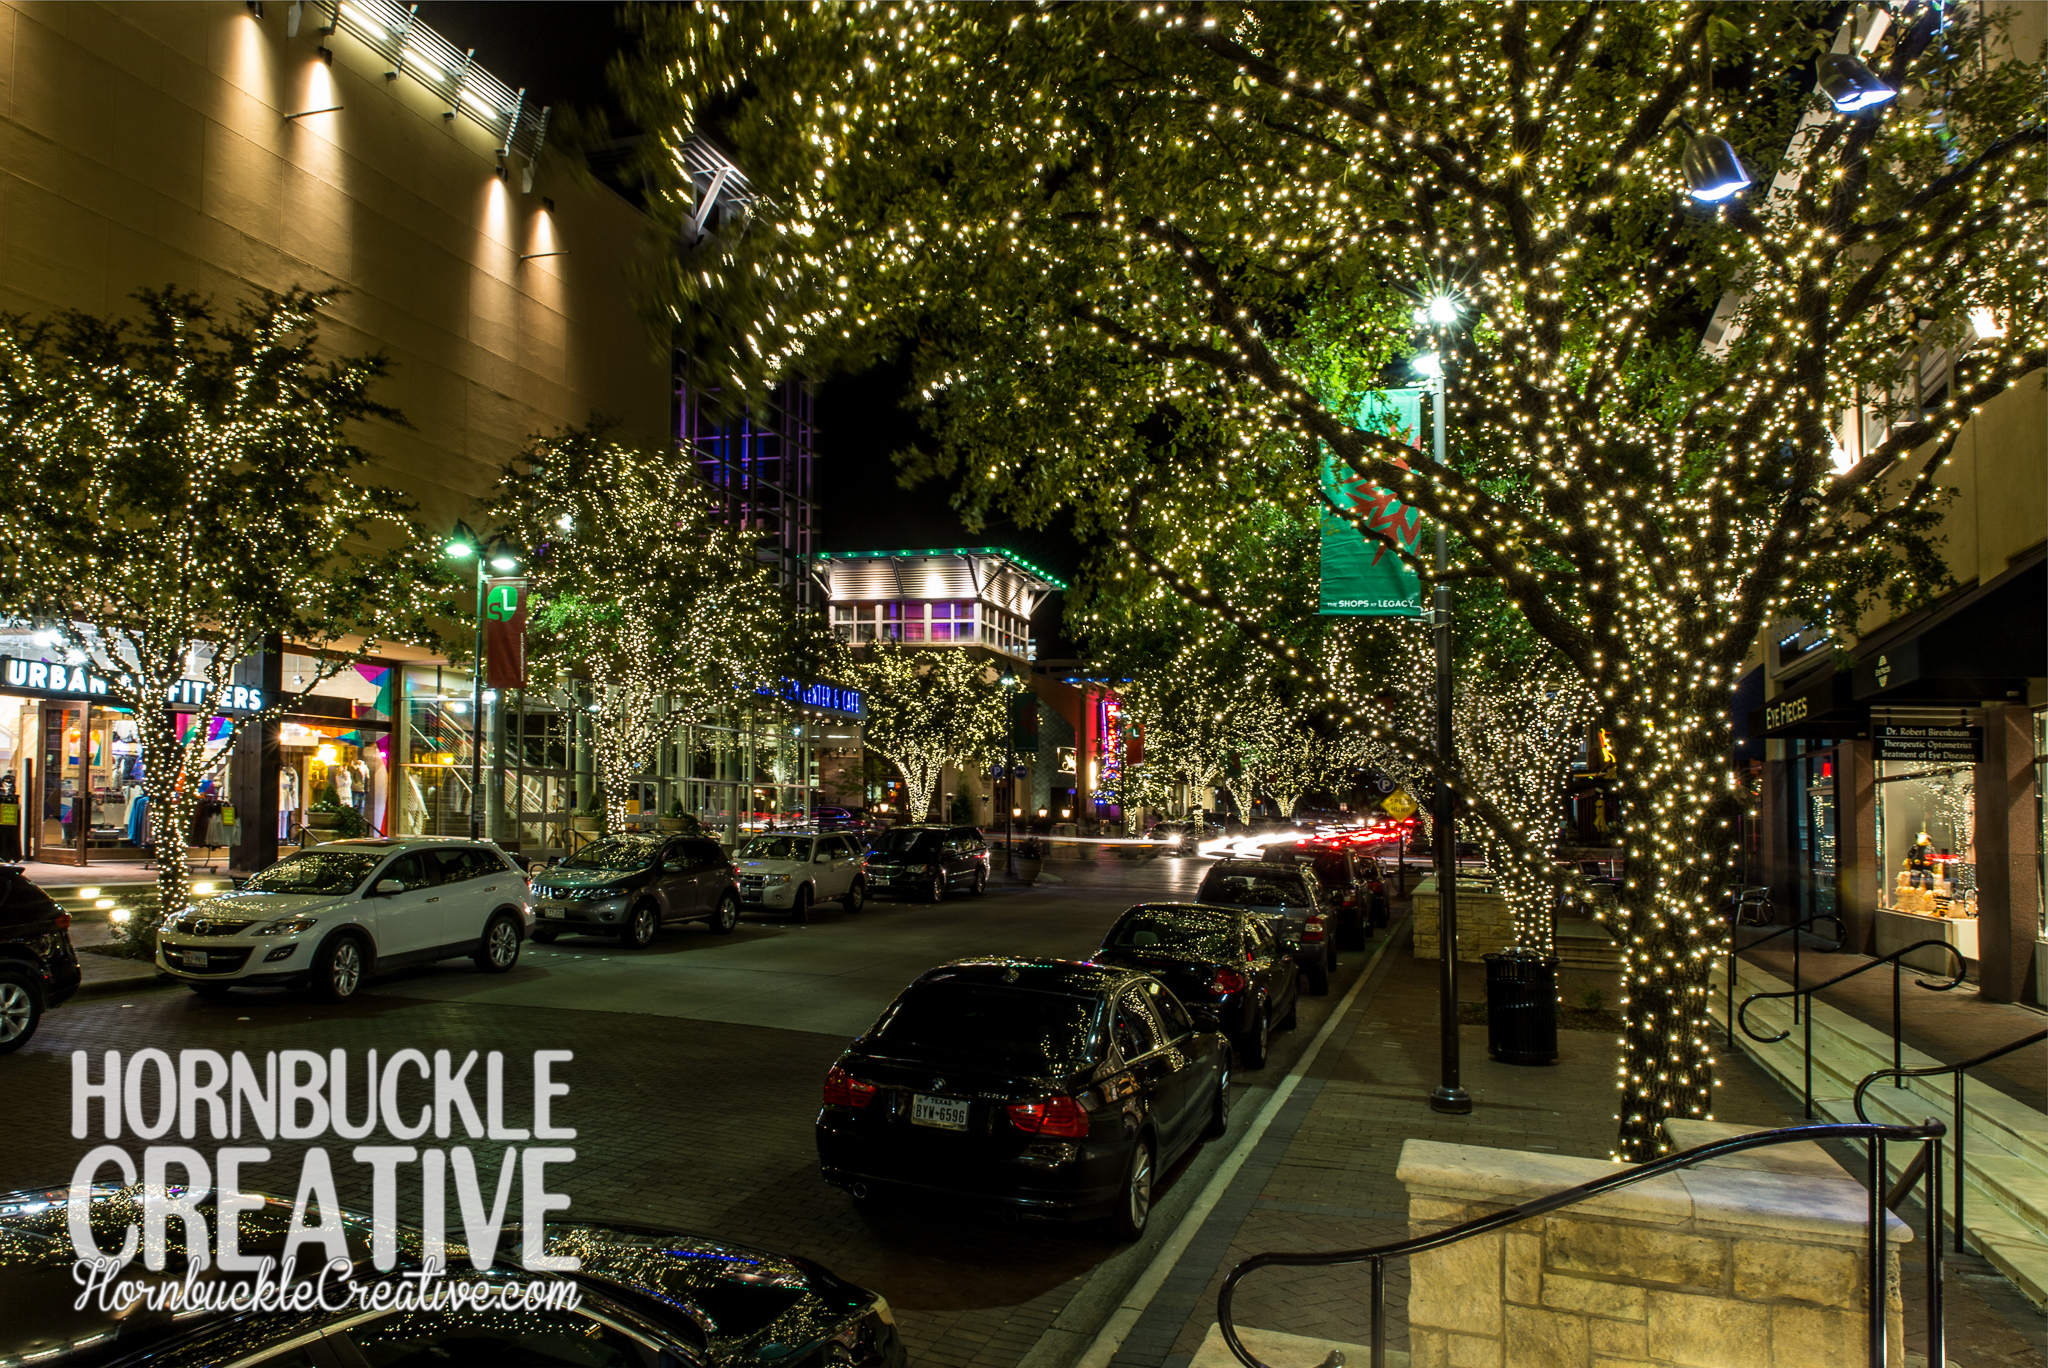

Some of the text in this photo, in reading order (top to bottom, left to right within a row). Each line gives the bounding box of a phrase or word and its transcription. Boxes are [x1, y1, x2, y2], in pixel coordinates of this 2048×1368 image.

[1338, 599, 1370, 608] SHOPS
[1378, 599, 1415, 608] LEGACY
[8, 660, 263, 711] URBAN FITERS
[833, 688, 840, 709] &
[841, 690, 861, 714] CAFE
[1765, 707, 1781, 730] EYE
[1885, 727, 1970, 737] Dr. Robert Birenbaum
[1883, 740, 1972, 750] Therapeutic Optometrist
[1881, 750, 1976, 760] Treatment of Eye Diseases
[1382, 780, 1391, 790] P
[931, 1097, 953, 1106] TEXAS
